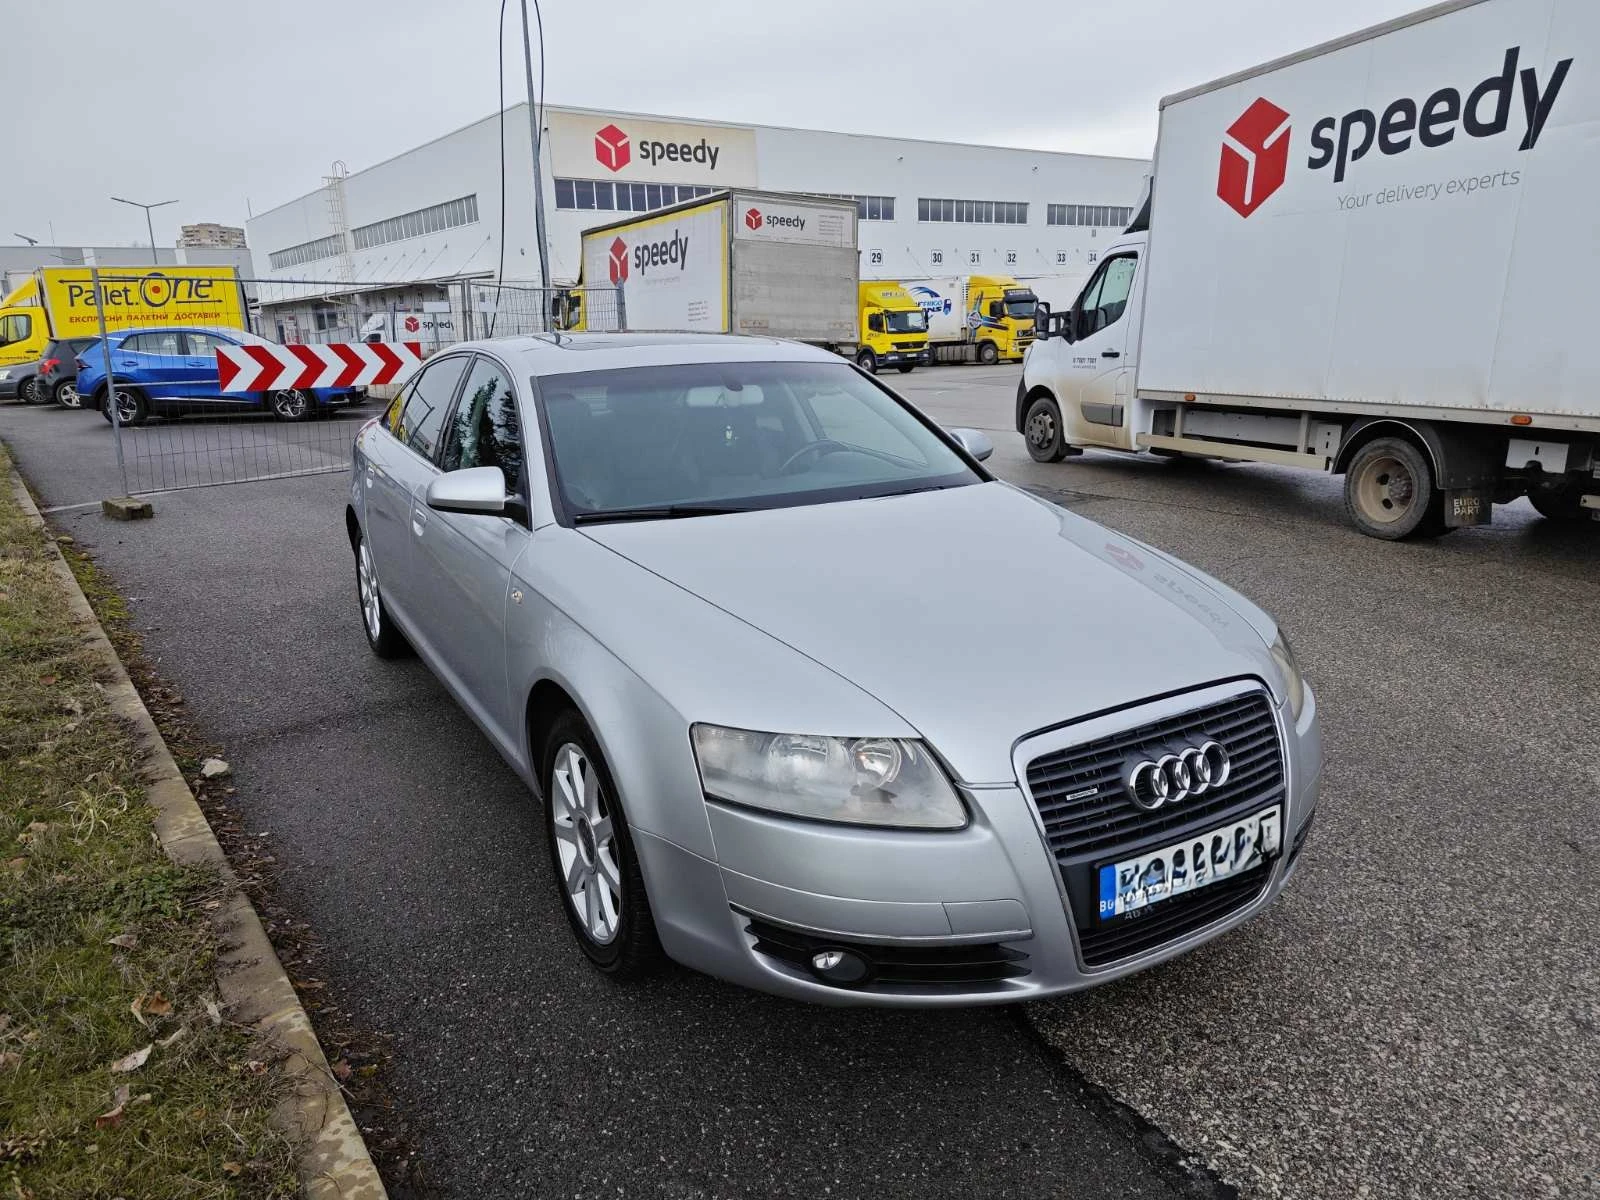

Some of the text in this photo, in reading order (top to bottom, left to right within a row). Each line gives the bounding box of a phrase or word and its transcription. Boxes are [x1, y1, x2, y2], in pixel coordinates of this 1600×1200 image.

[1307, 45, 1574, 183] speedy
[639, 138, 720, 170] speedy
[1337, 170, 1521, 210] Your delivery experts
[766, 210, 806, 231] speedy
[634, 229, 689, 276] speedy
[871, 252, 882, 263] 29
[932, 252, 942, 263] 30
[970, 252, 980, 263] 31
[1007, 252, 1017, 263] 32
[1057, 252, 1067, 263] 33
[1089, 252, 1098, 262] 34
[68, 314, 123, 324] ЕКСПРСНИ
[173, 312, 221, 321] ДОСТАВКИ
[1453, 497, 1480, 507] EURO
[1453, 505, 1480, 516] PART
